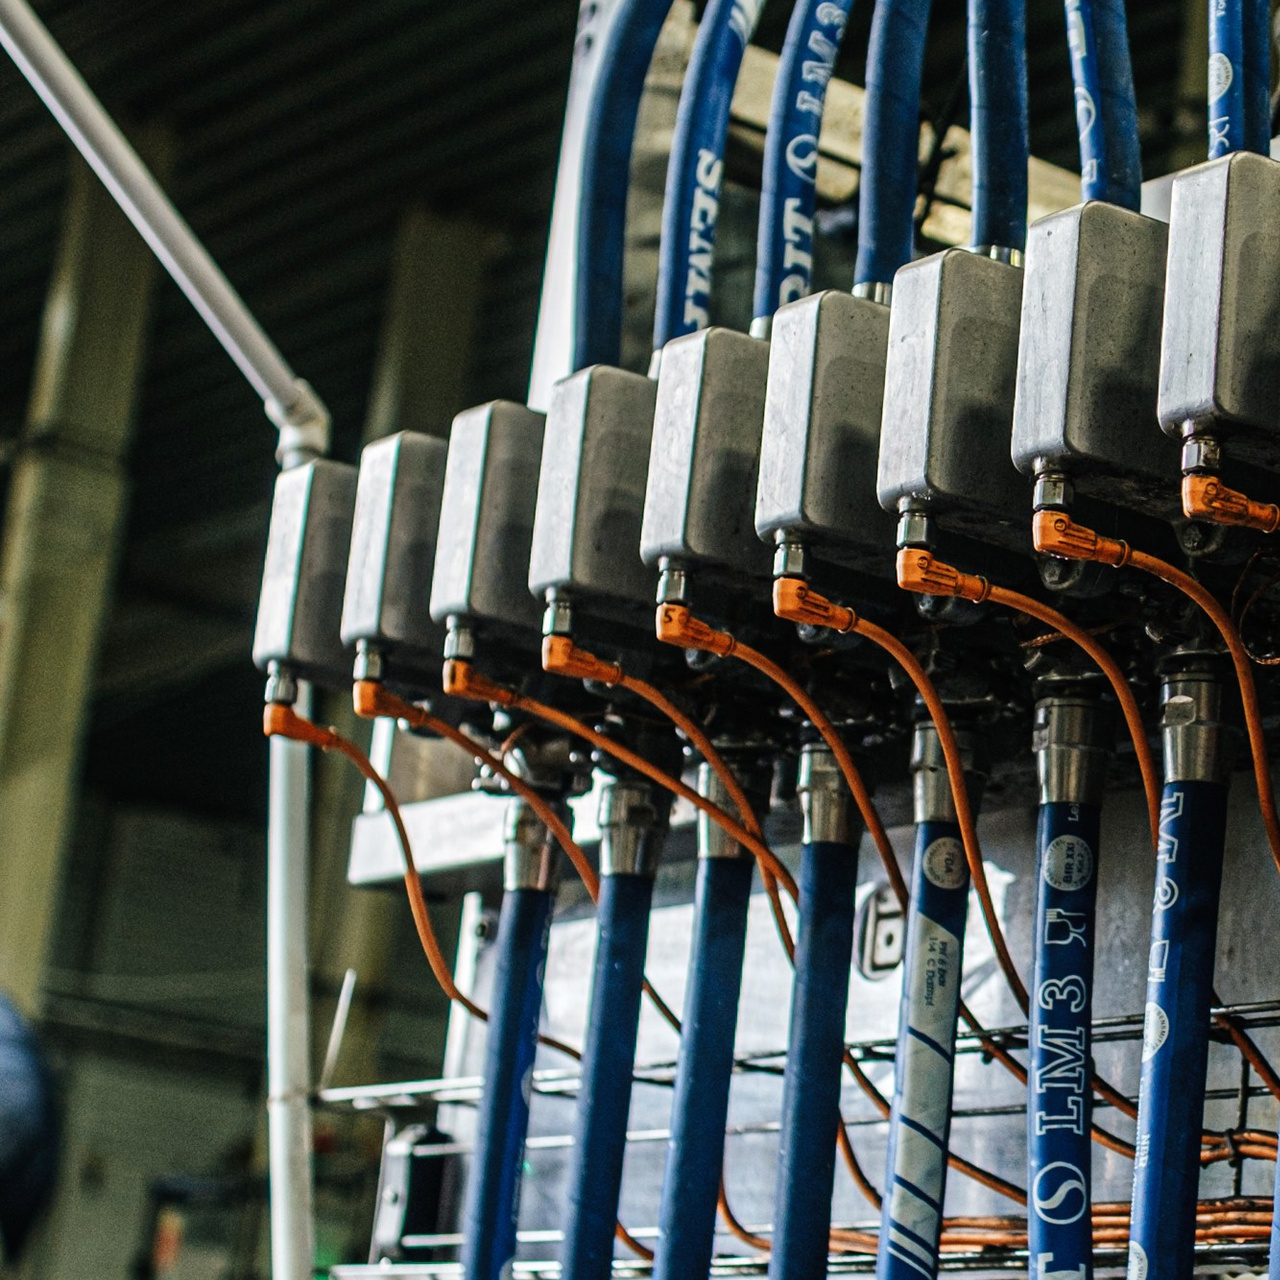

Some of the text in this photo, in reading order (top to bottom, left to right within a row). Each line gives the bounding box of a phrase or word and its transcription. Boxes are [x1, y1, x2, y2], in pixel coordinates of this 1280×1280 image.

[1062, 842, 1075, 884] BfR XXI
[1040, 974, 1086, 1013] 3
[1036, 1026, 1086, 1137] LM
